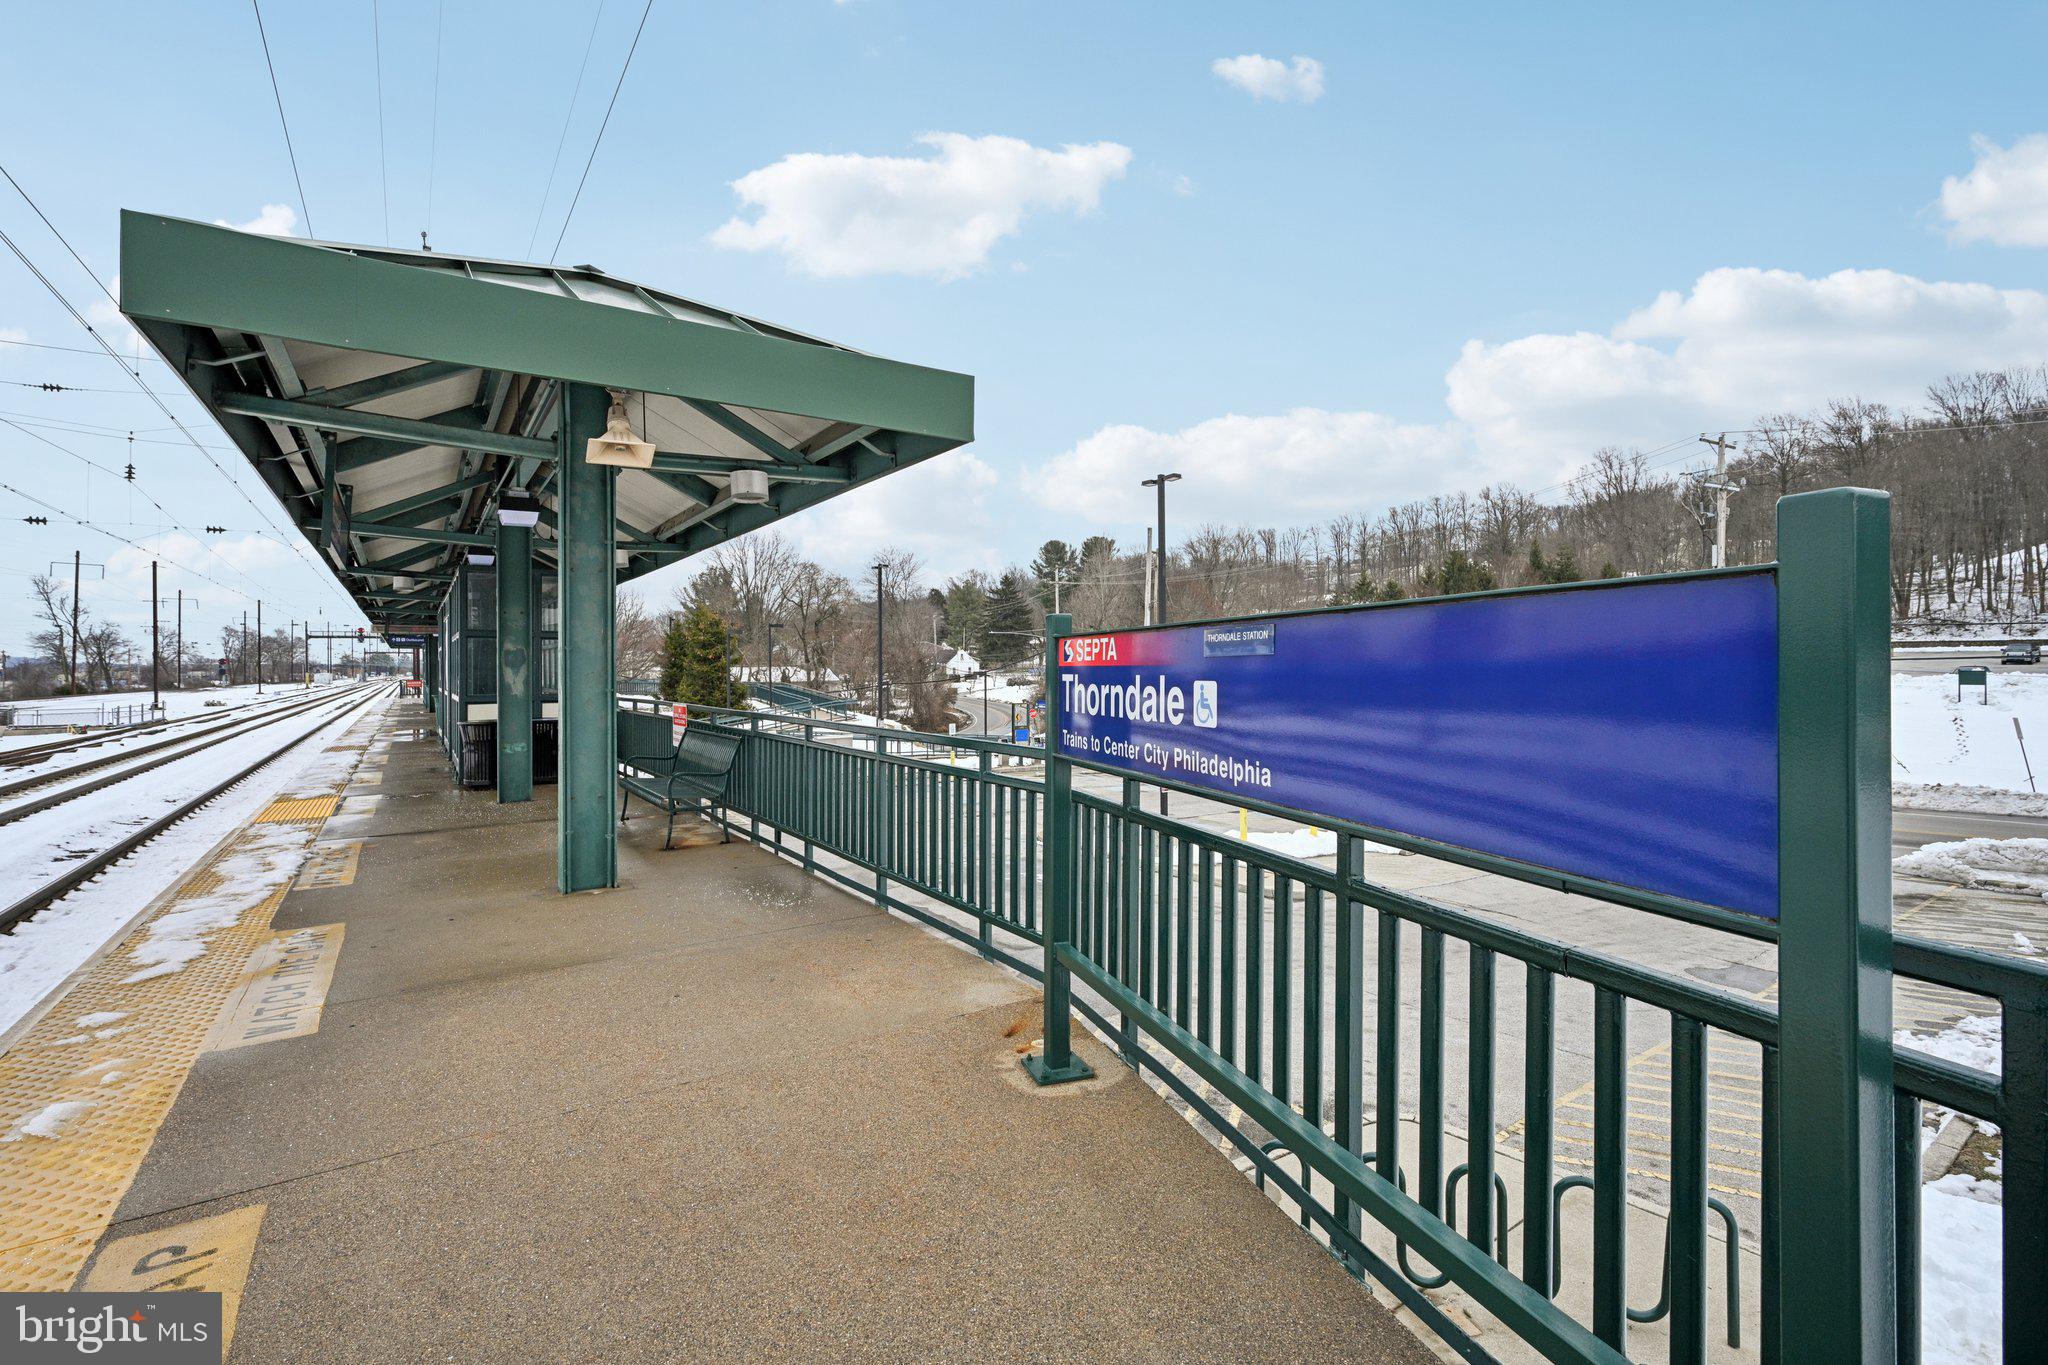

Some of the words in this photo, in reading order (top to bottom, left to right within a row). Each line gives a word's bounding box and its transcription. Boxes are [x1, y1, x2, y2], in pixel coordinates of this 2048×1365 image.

[1075, 637, 1118, 663] SEPTA
[1208, 633, 1241, 643] THORNDALE
[1242, 629, 1269, 641] STATION
[1061, 673, 1185, 726] Thorndale
[1062, 729, 1088, 750] Trains
[1090, 734, 1101, 752] to
[1103, 735, 1140, 760] Center
[1143, 742, 1169, 771] City
[1173, 747, 1272, 788] Philadelphia
[270, 954, 320, 981] THE
[242, 980, 312, 1040] WATCH
